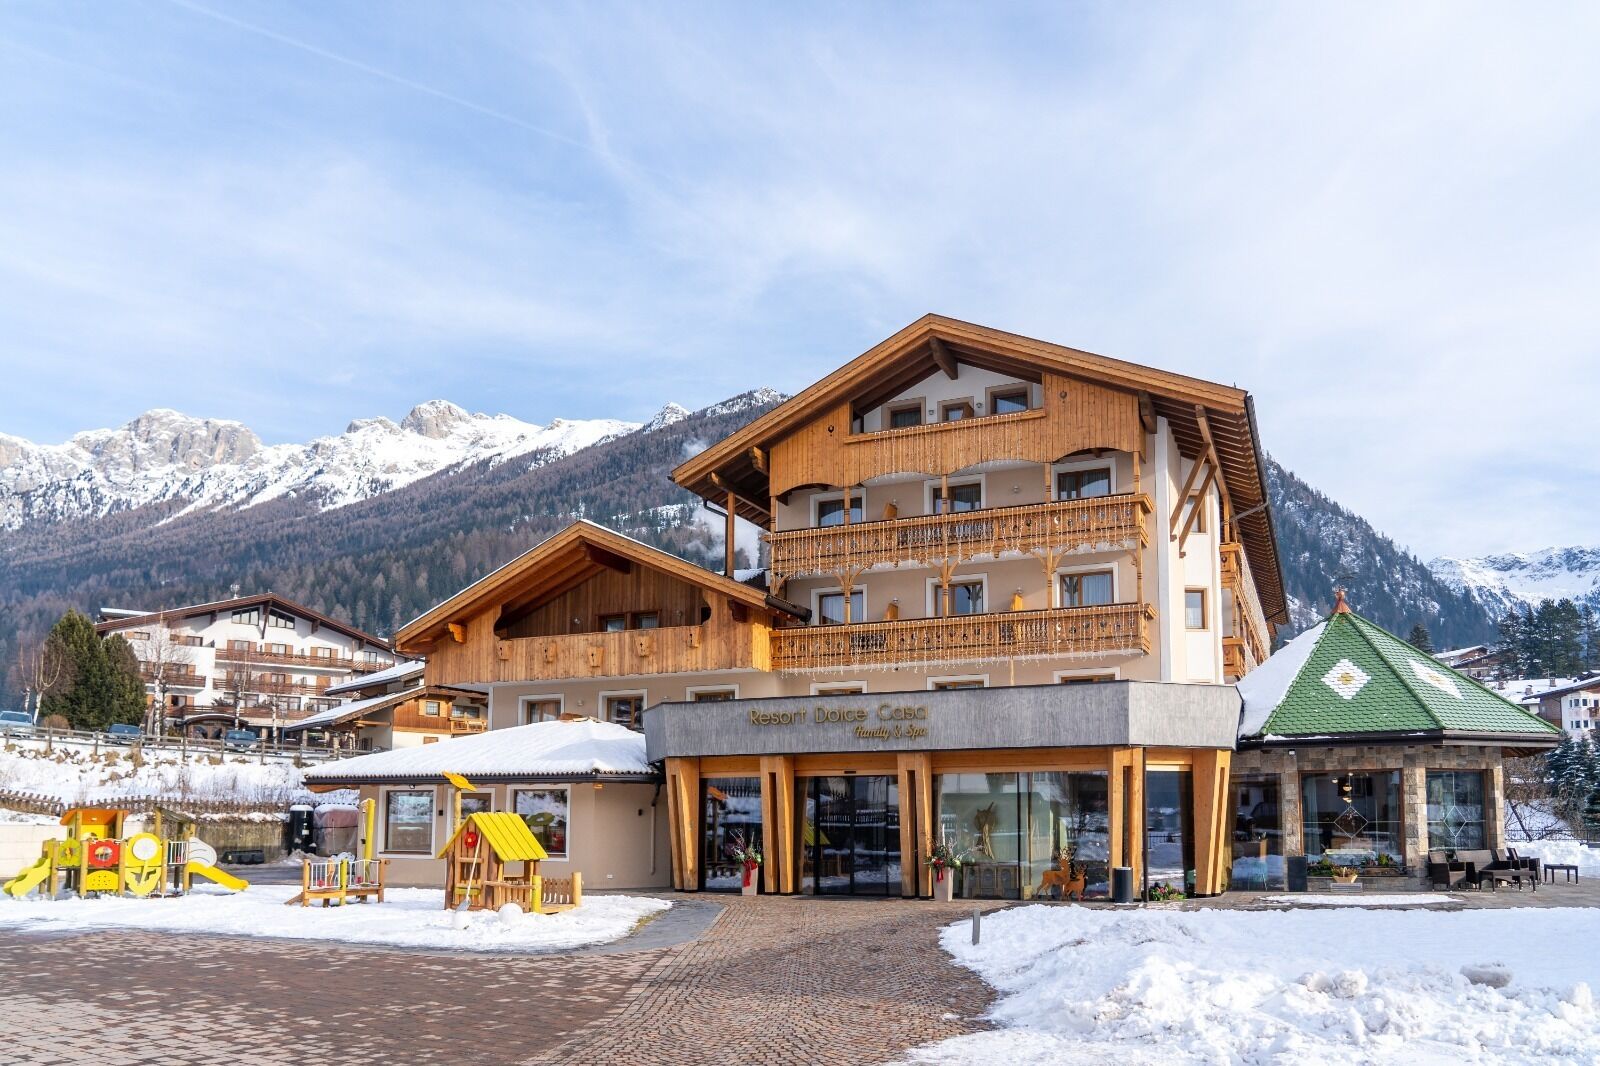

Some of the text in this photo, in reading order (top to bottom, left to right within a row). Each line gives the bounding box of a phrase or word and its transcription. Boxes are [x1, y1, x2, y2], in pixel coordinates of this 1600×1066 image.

[750, 703, 928, 725] Resort Dolce Casa
[854, 724, 927, 740] Family & Spa
